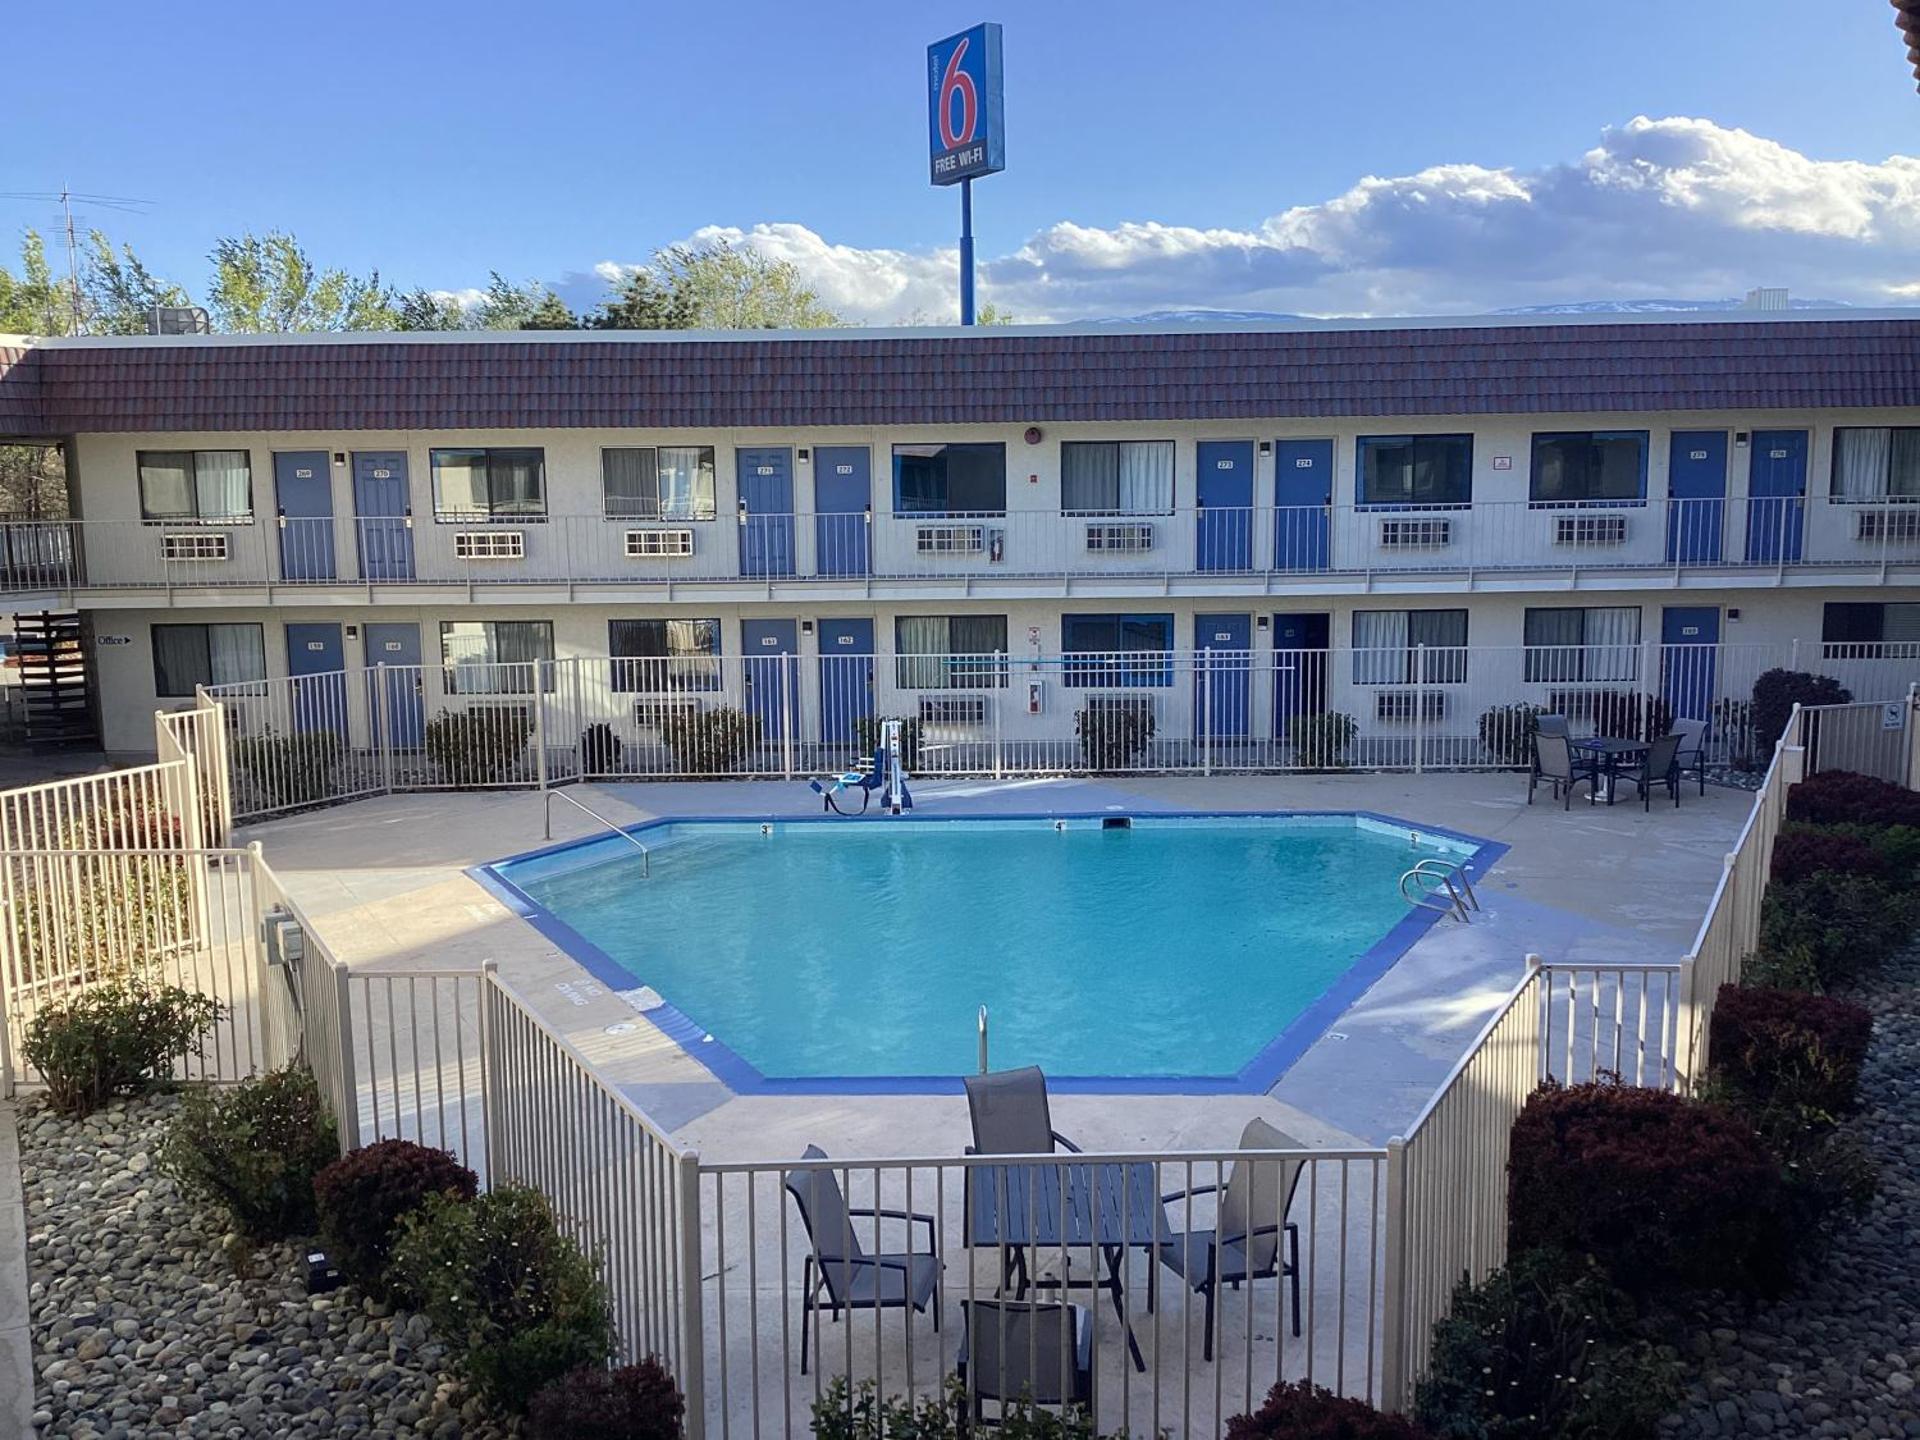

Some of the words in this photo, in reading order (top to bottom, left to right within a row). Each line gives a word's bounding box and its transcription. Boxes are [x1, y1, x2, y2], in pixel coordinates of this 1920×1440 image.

[939, 37, 977, 150] 6
[935, 155, 956, 174] FREE
[959, 147, 983, 167] WI-FI
[98, 635, 123, 646] Office
